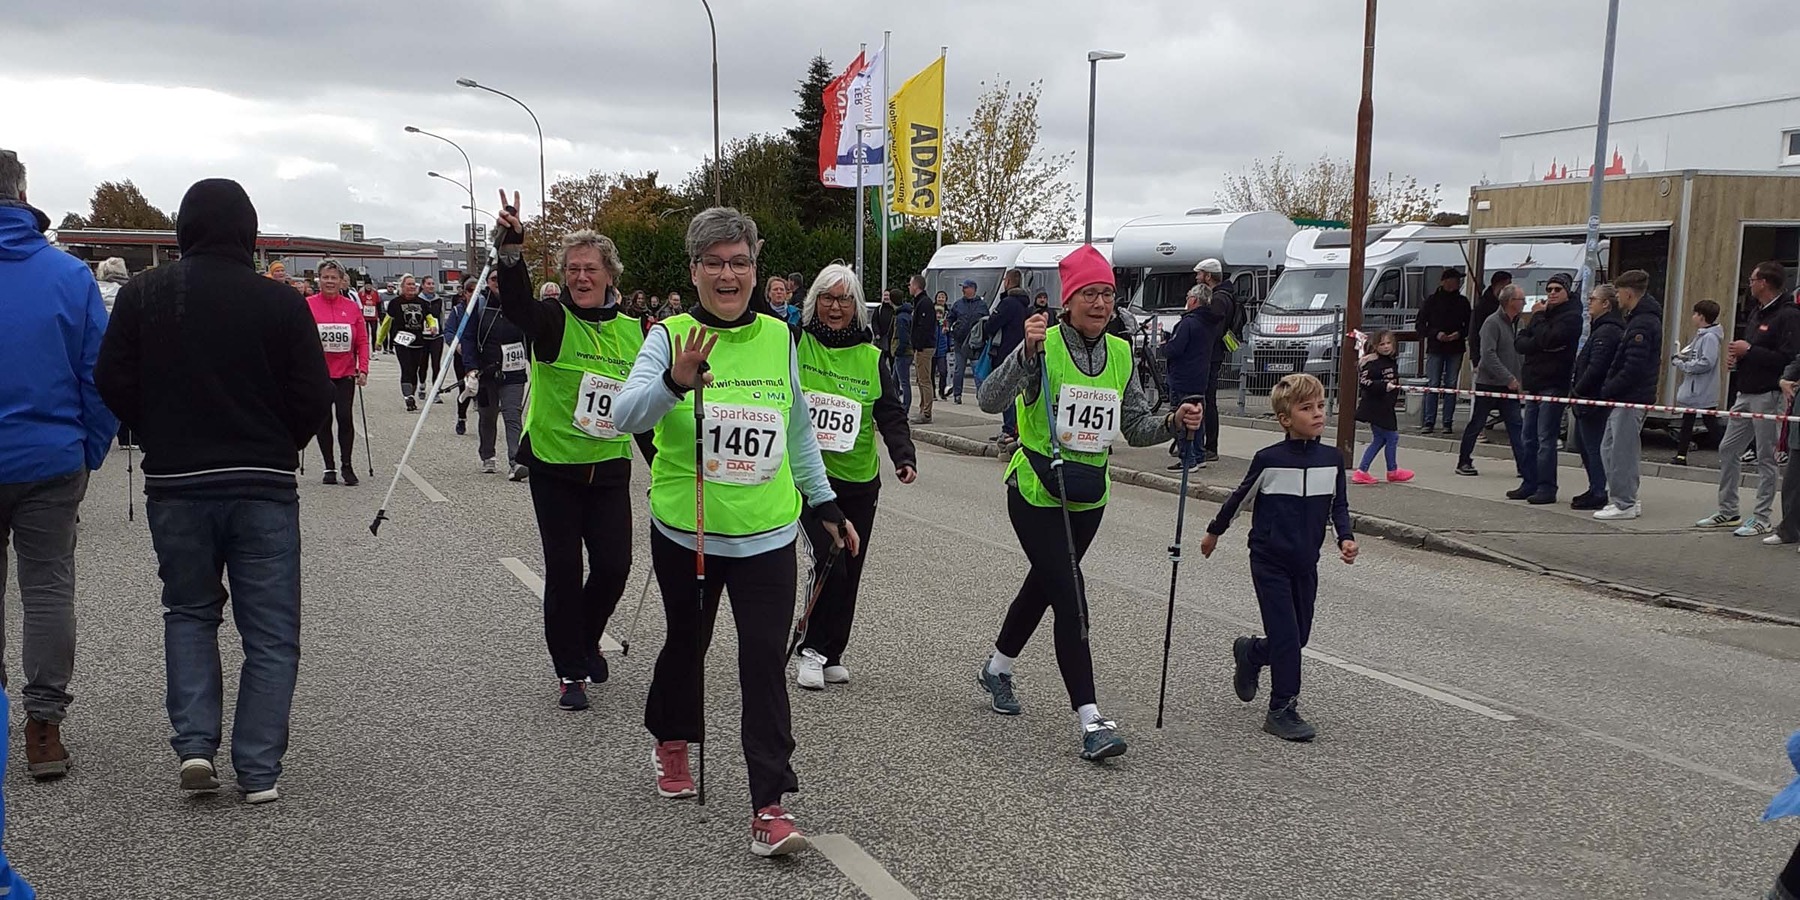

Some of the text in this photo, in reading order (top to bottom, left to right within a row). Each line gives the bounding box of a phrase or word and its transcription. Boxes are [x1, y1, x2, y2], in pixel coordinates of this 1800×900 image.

[911, 122, 938, 208] ADAC
[321, 332, 349, 343] 2396
[809, 394, 856, 411] Sparkasse
[1069, 387, 1117, 402] Sparkasse
[585, 391, 612, 418] 19
[712, 406, 776, 423] Sparkasse
[809, 407, 855, 434] 2058
[1065, 403, 1114, 431] 1451
[709, 425, 777, 458] 1467
[816, 432, 836, 441] DAK
[1077, 431, 1099, 441] DAK
[726, 459, 756, 471] DAK
